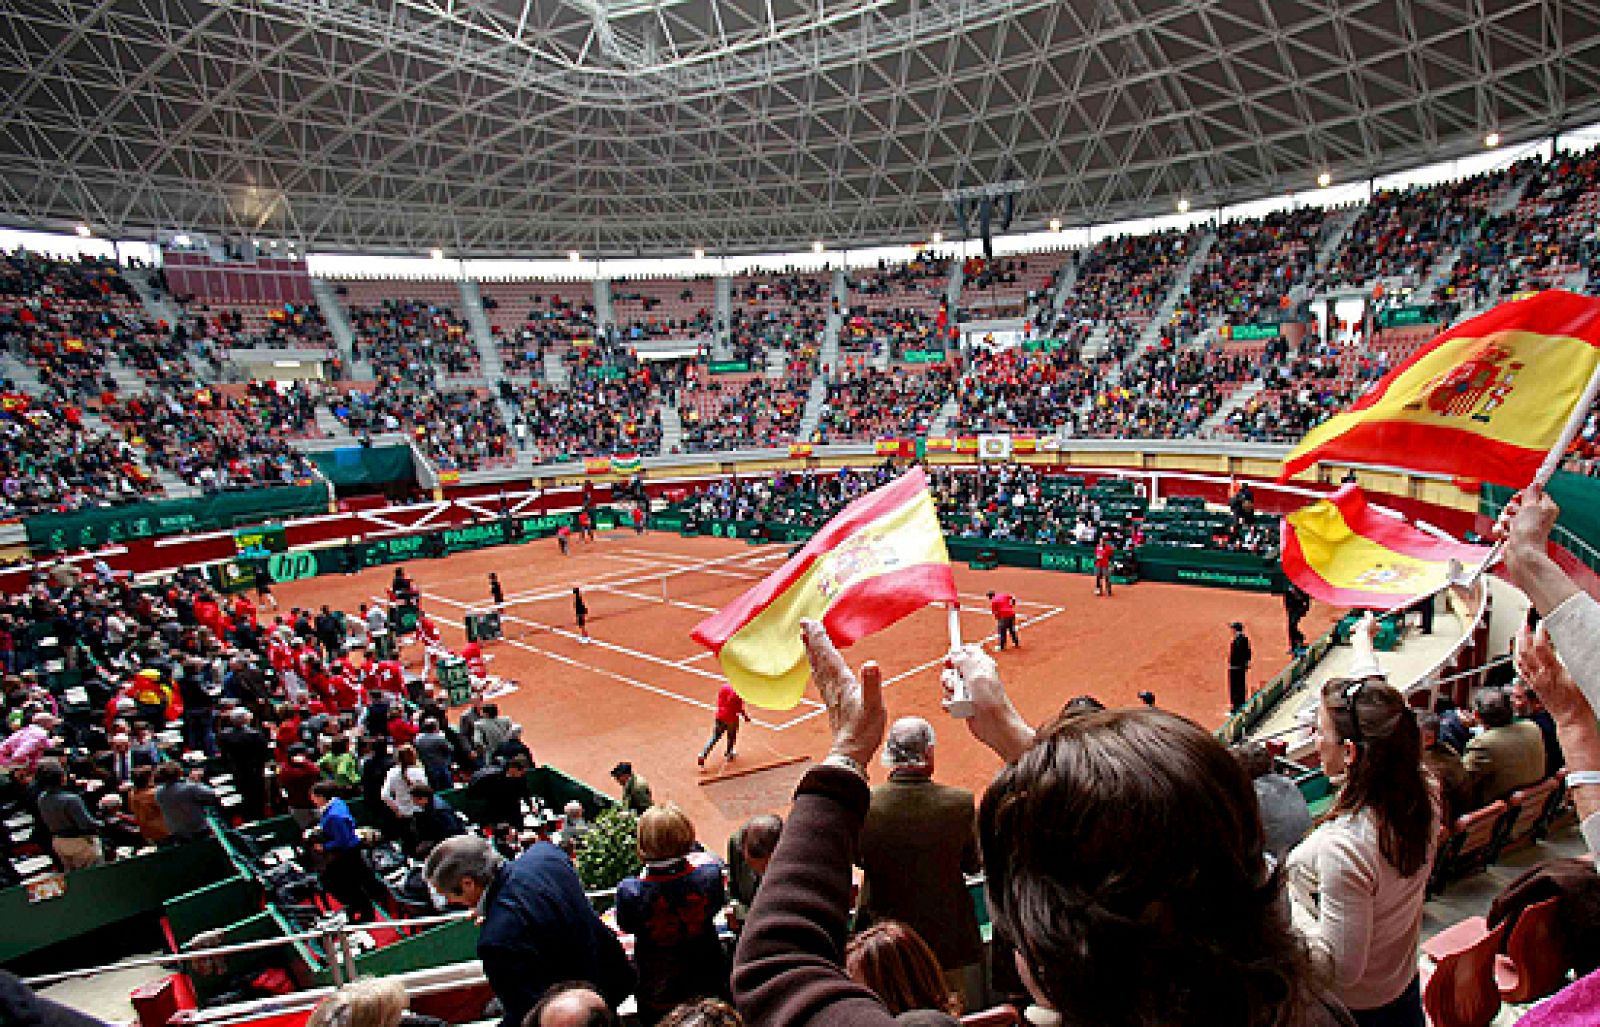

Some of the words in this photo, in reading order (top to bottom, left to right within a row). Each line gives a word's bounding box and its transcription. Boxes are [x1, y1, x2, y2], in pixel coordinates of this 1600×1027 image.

[390, 536, 423, 553] BNP
[444, 523, 504, 544] PARIBAS
[275, 553, 313, 581] hp
